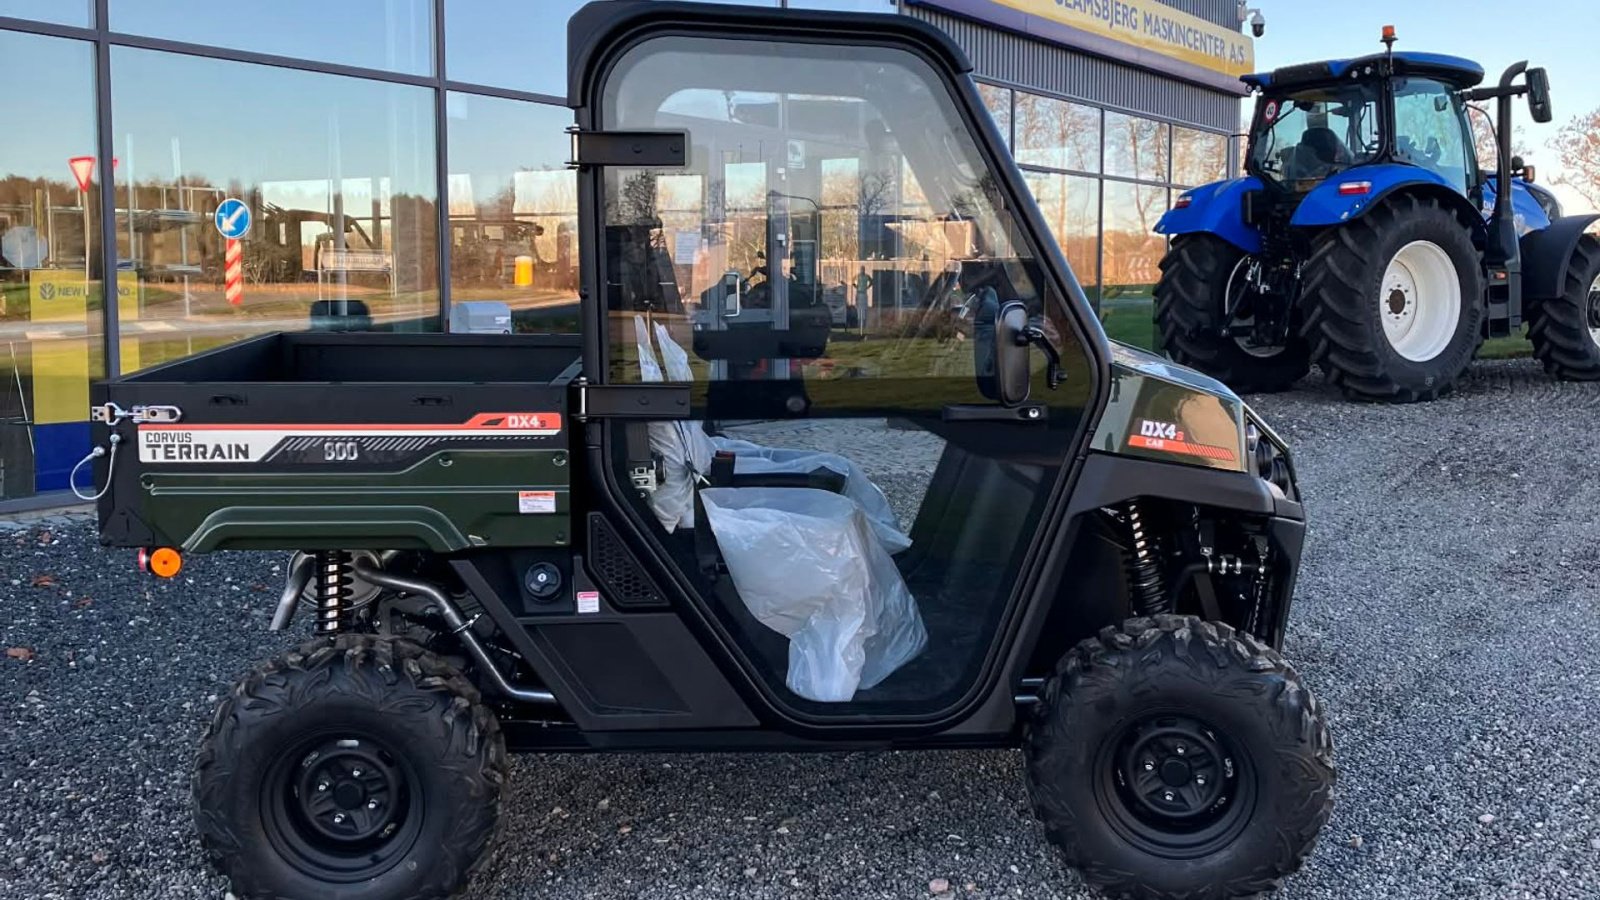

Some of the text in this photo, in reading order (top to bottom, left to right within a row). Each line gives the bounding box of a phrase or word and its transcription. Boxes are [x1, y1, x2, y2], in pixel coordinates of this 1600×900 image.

[1055, 0, 1245, 65] AMSBJERG MASKINCENTER A/S
[58, 287, 82, 296] NEW
[146, 432, 192, 443] CORVUS
[146, 443, 249, 460] TERRAIN
[324, 441, 358, 460] 800
